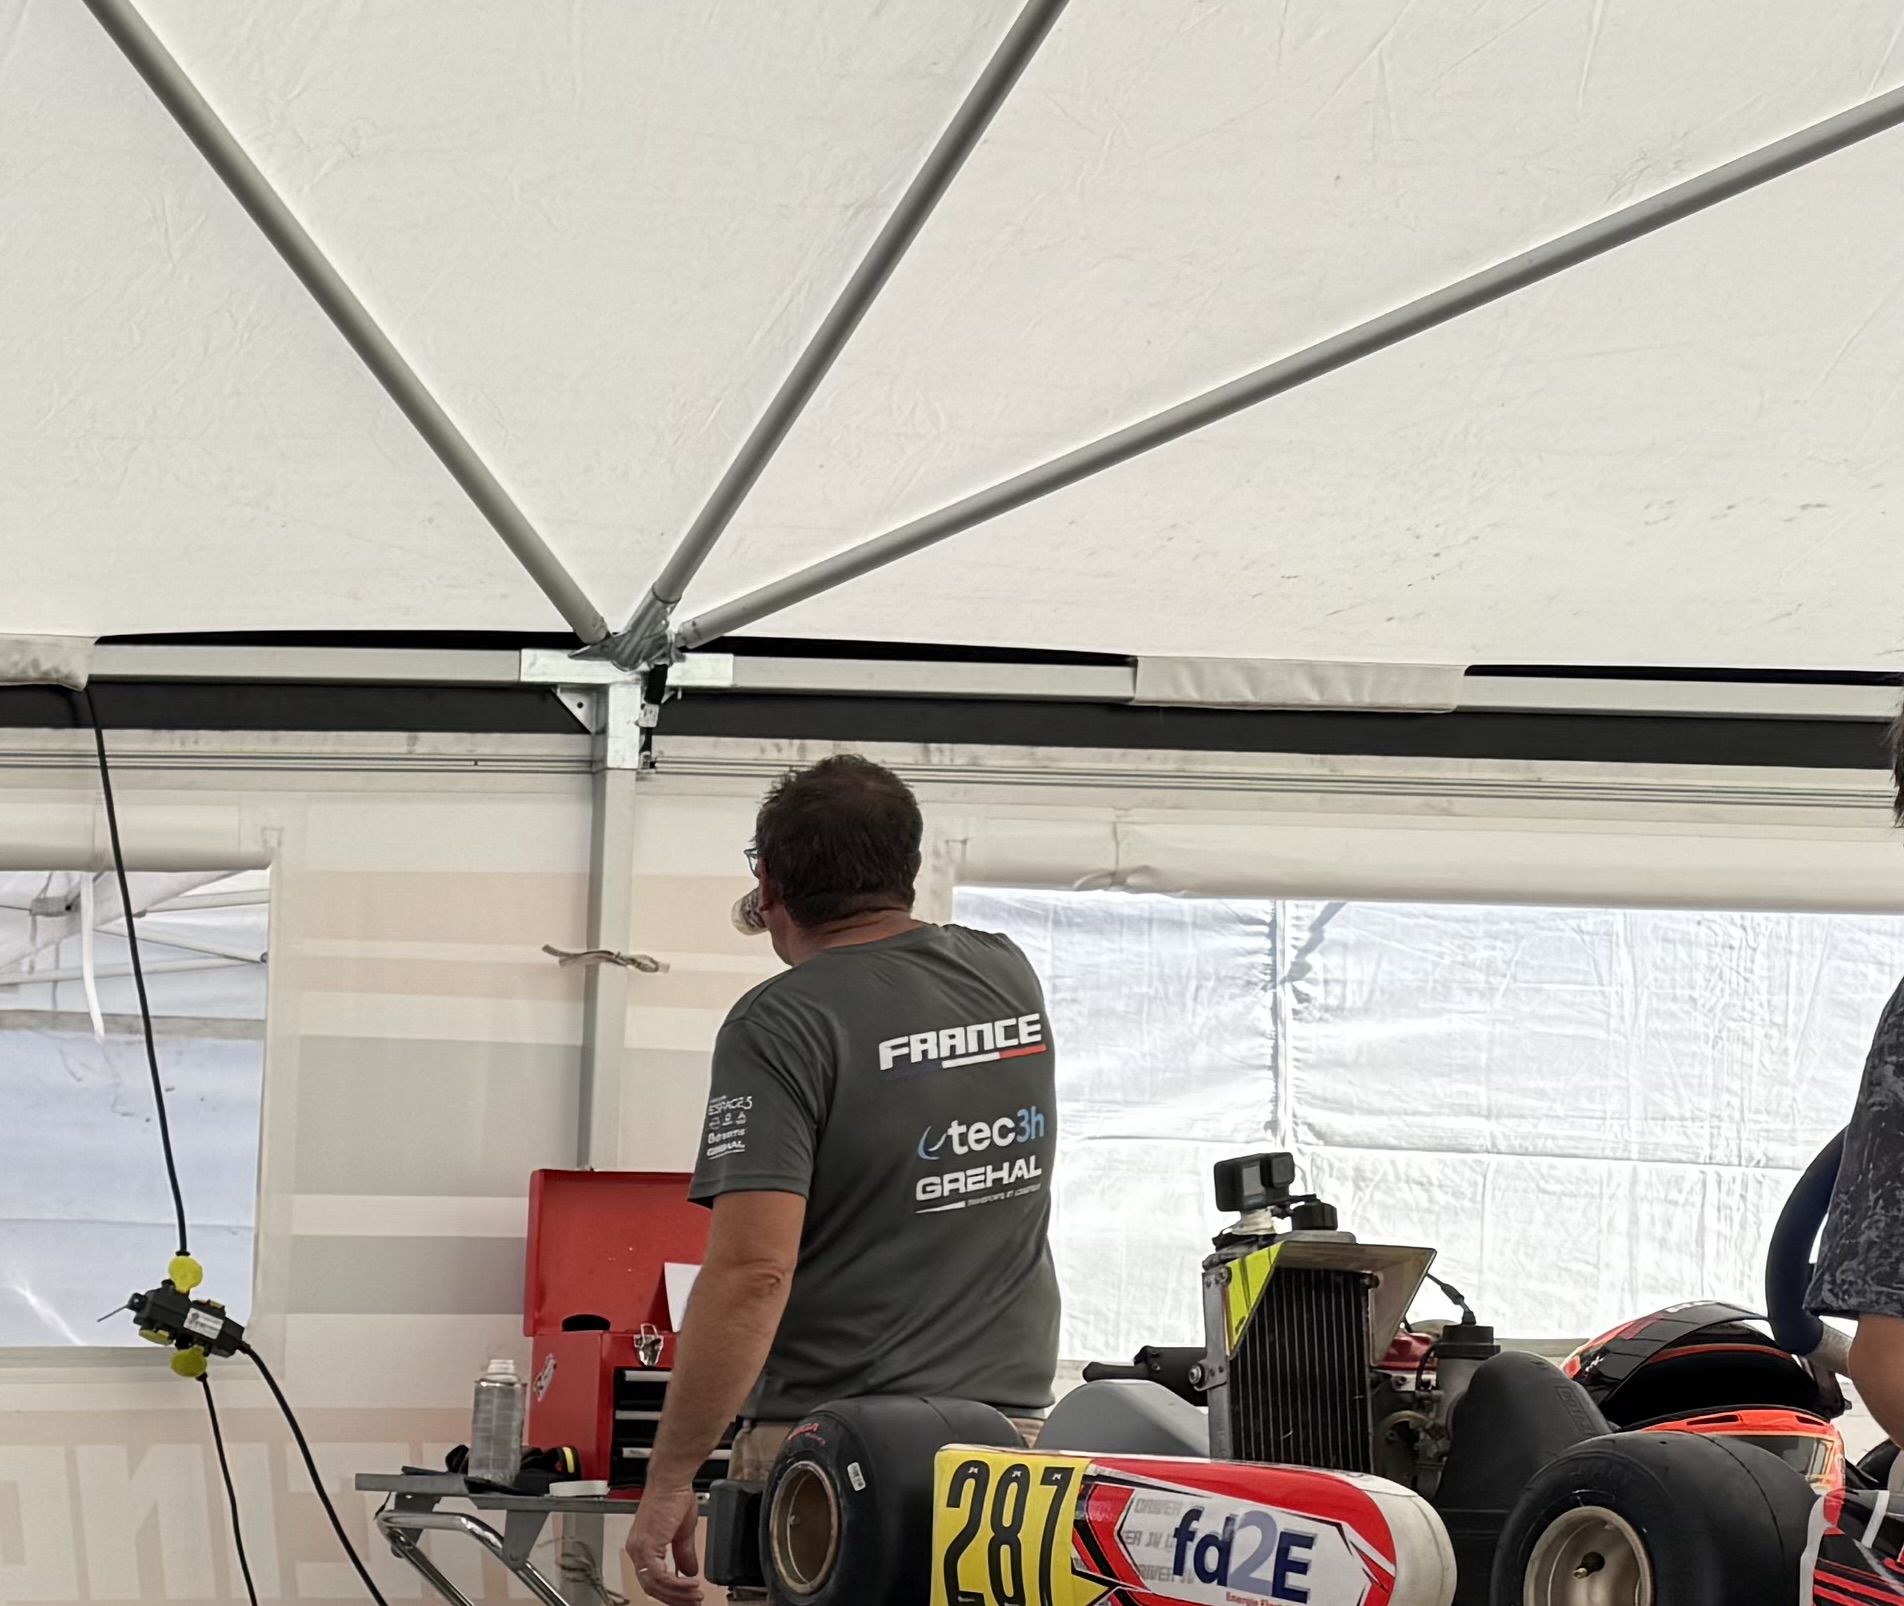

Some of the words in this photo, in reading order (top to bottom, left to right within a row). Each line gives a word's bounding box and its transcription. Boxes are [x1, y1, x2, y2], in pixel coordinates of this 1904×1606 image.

[879, 1012, 1042, 1071] FRANCE
[949, 1106, 1045, 1157] tec3h
[916, 1155, 1042, 1201] GREHAL
[1173, 1505, 1317, 1604] fd2E
